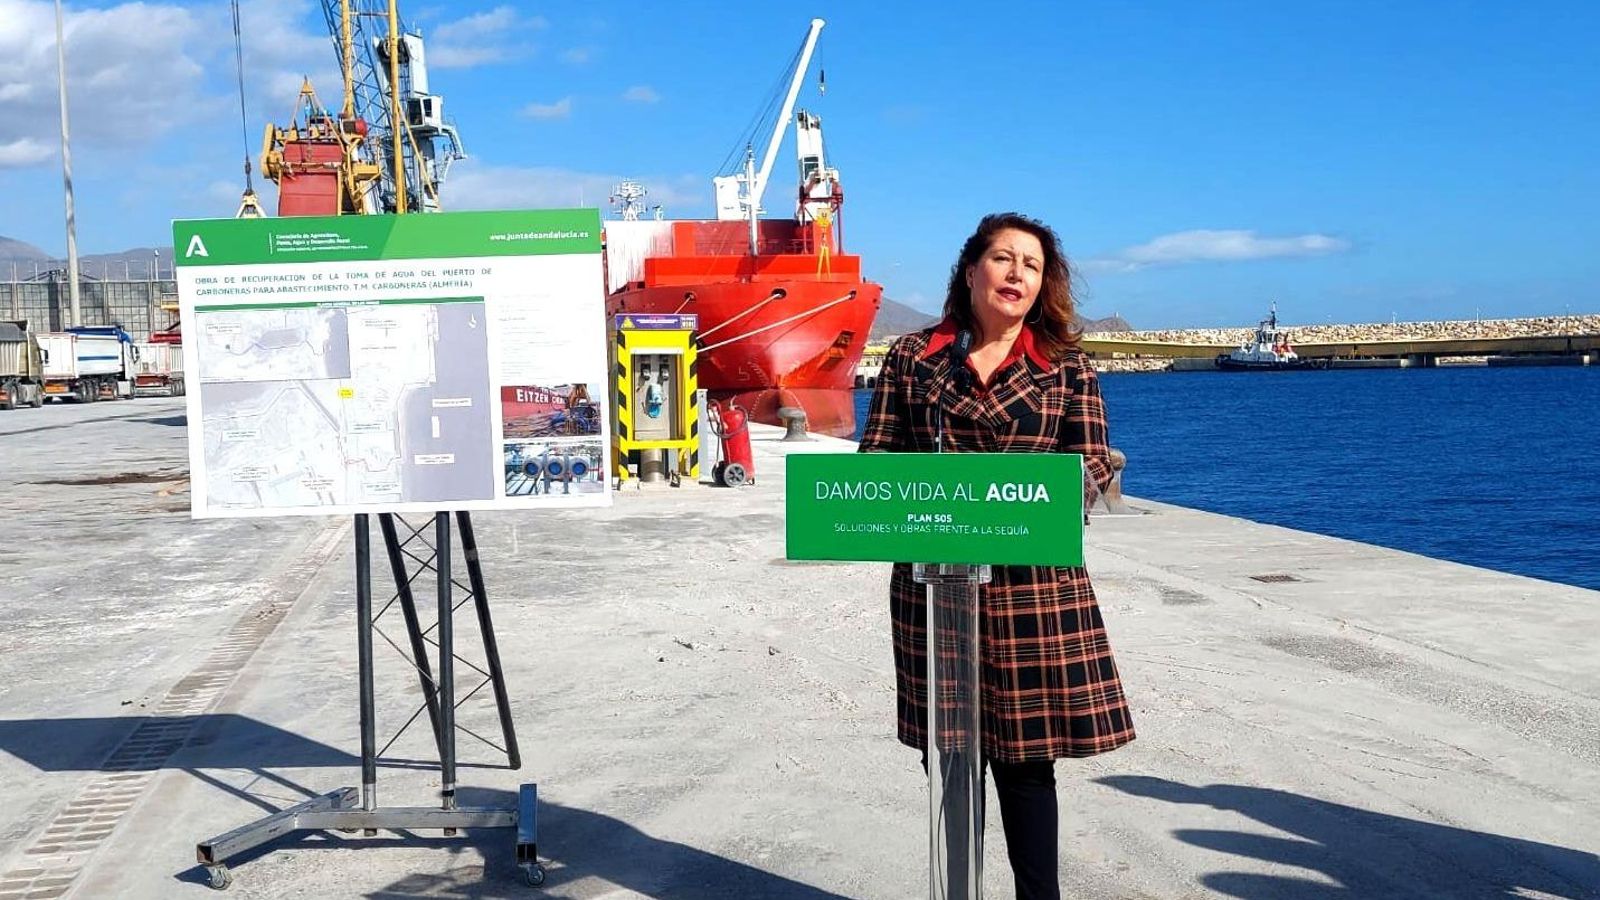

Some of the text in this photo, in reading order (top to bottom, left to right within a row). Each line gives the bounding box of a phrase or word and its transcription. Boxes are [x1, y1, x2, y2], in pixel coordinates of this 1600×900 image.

[195, 277, 218, 285] OBRA
[224, 276, 236, 284] DE
[312, 273, 323, 281] DE
[346, 272, 369, 280] TOMA
[443, 268, 475, 276] PUERTO
[481, 267, 492, 275] DE
[196, 286, 251, 296] CARBONERAS
[253, 286, 275, 294] PARA
[372, 281, 427, 290] CARBONERAS
[816, 481, 1051, 503] DAMOS VIDA AL AGUA
[907, 513, 953, 524] PLAN SOS
[834, 523, 1030, 536] SOLUCIONES Y OBRAS FRENTE A LA SEQUÍA
